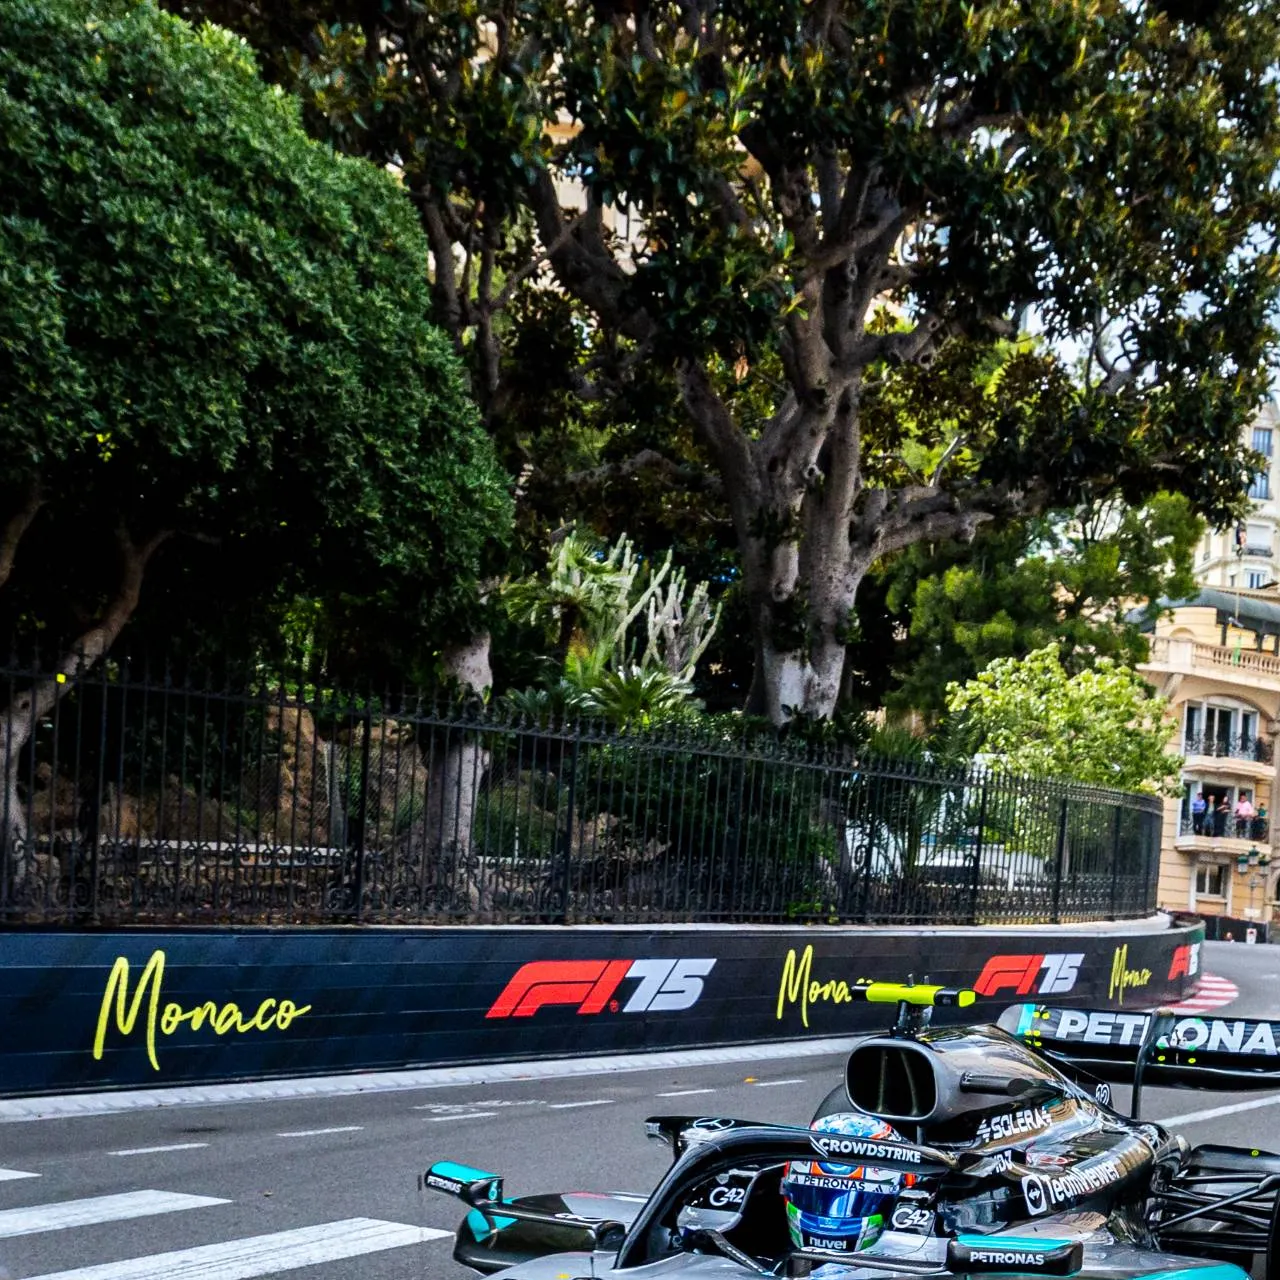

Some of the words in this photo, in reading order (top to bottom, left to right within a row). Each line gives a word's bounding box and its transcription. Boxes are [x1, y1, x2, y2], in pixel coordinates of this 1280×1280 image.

[623, 958, 717, 1013] 75
[776, 944, 874, 1028] Mona
[1038, 953, 1085, 994] 75
[1108, 944, 1152, 1005] Monaco
[93, 950, 311, 1070] Monaco
[991, 1109, 1046, 1140] SOLERA
[819, 1138, 921, 1163] CROWDSTRIKE
[709, 1186, 745, 1206] G42
[804, 1176, 866, 1191] PETRONAS
[1041, 1159, 1120, 1205] TeamViewer
[891, 1208, 932, 1229] G42
[969, 1251, 1045, 1266] PETRONAS
